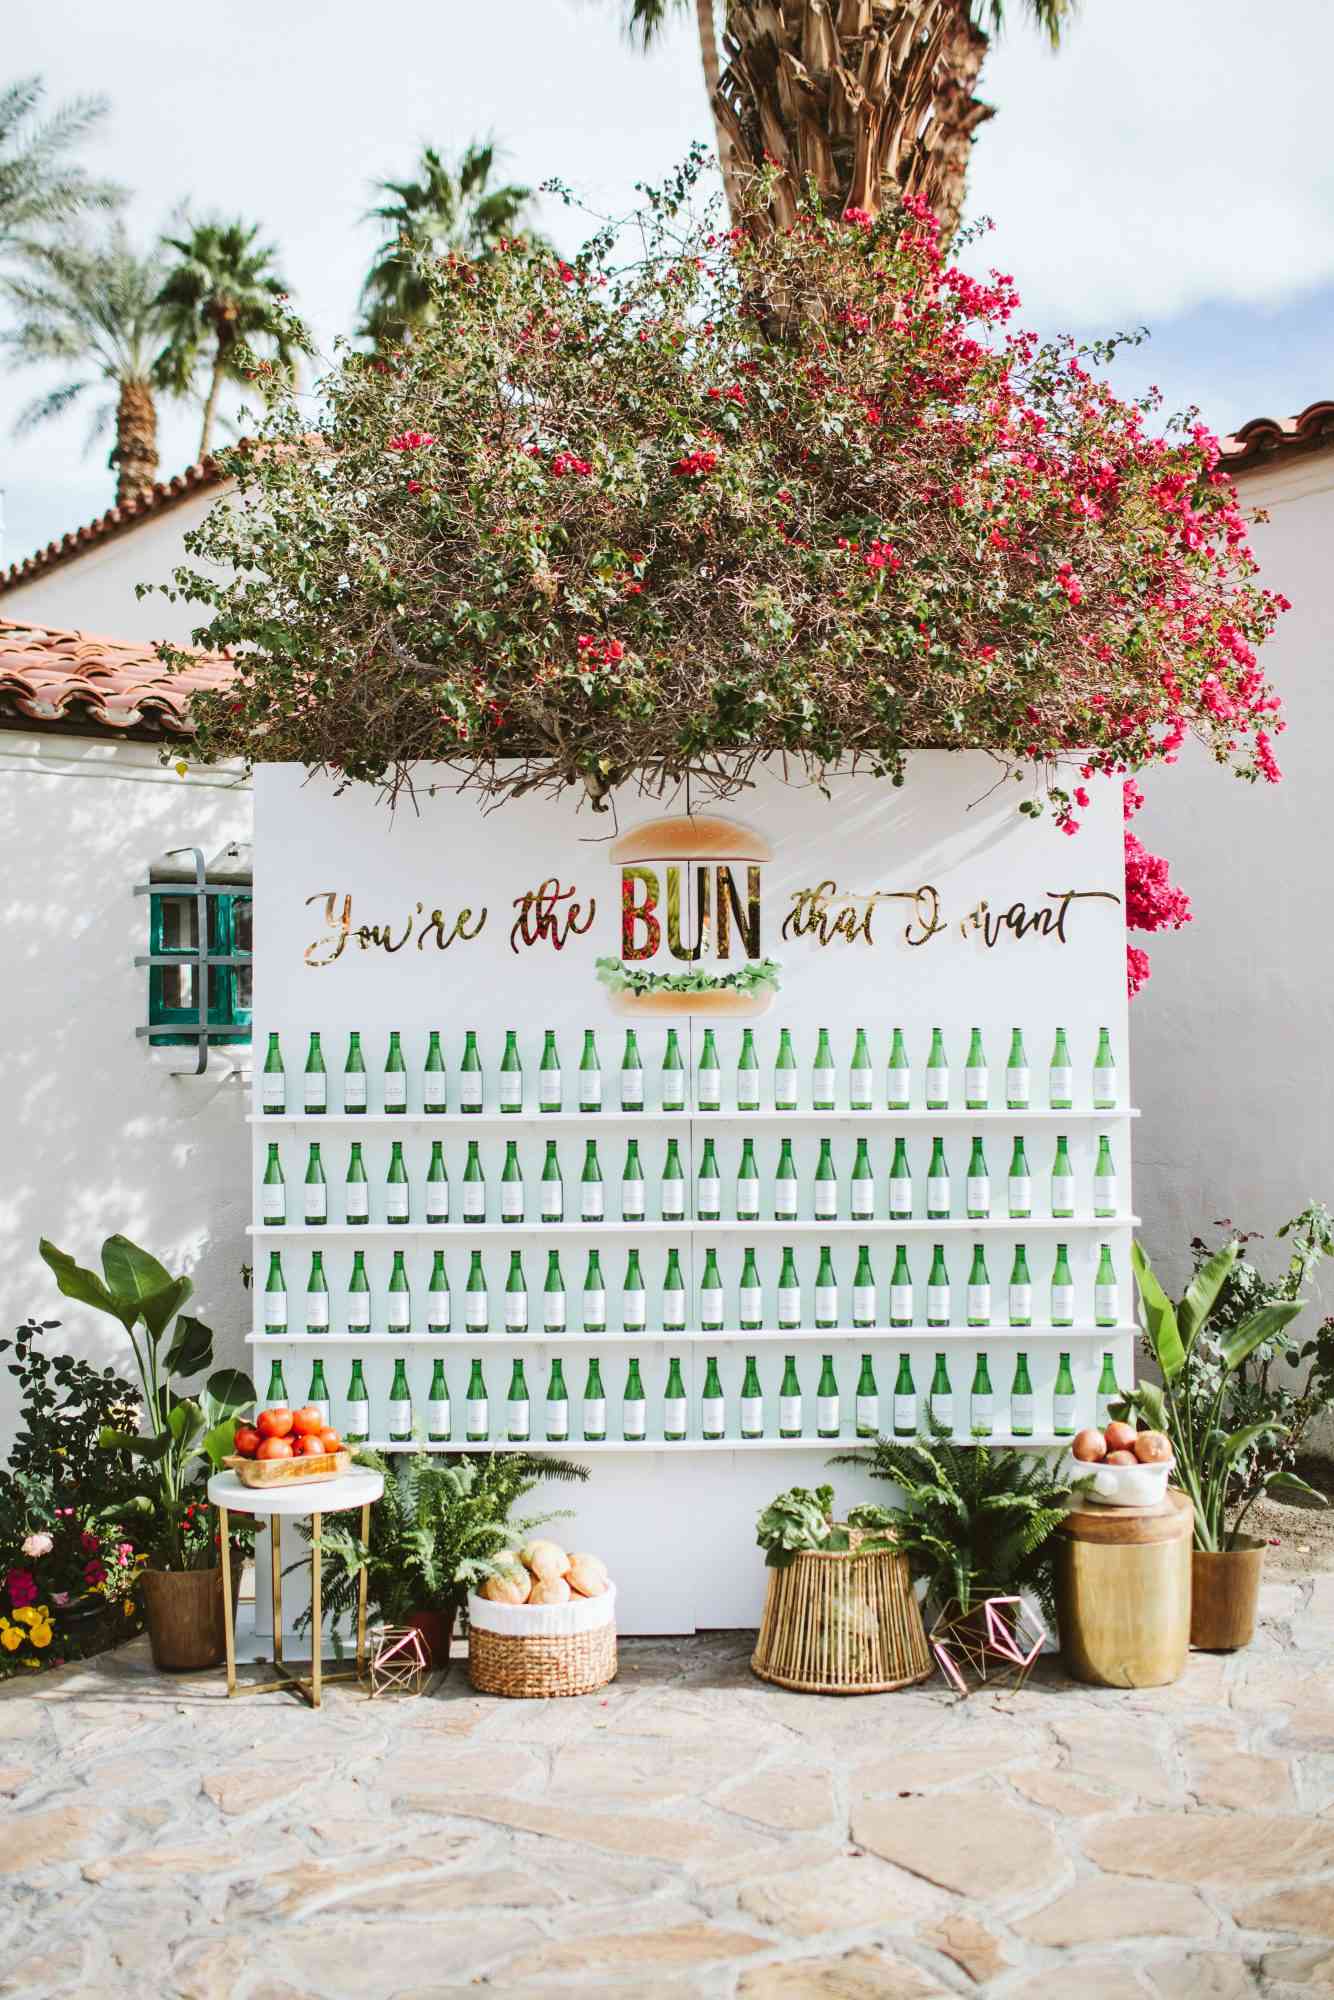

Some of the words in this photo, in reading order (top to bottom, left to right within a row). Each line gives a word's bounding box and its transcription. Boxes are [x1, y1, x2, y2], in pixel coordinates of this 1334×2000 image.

[304, 892, 488, 966] You're
[511, 878, 597, 954] the
[621, 866, 760, 961] BUN
[782, 880, 904, 946] that
[905, 885, 948, 946] I
[960, 889, 1120, 947] want
